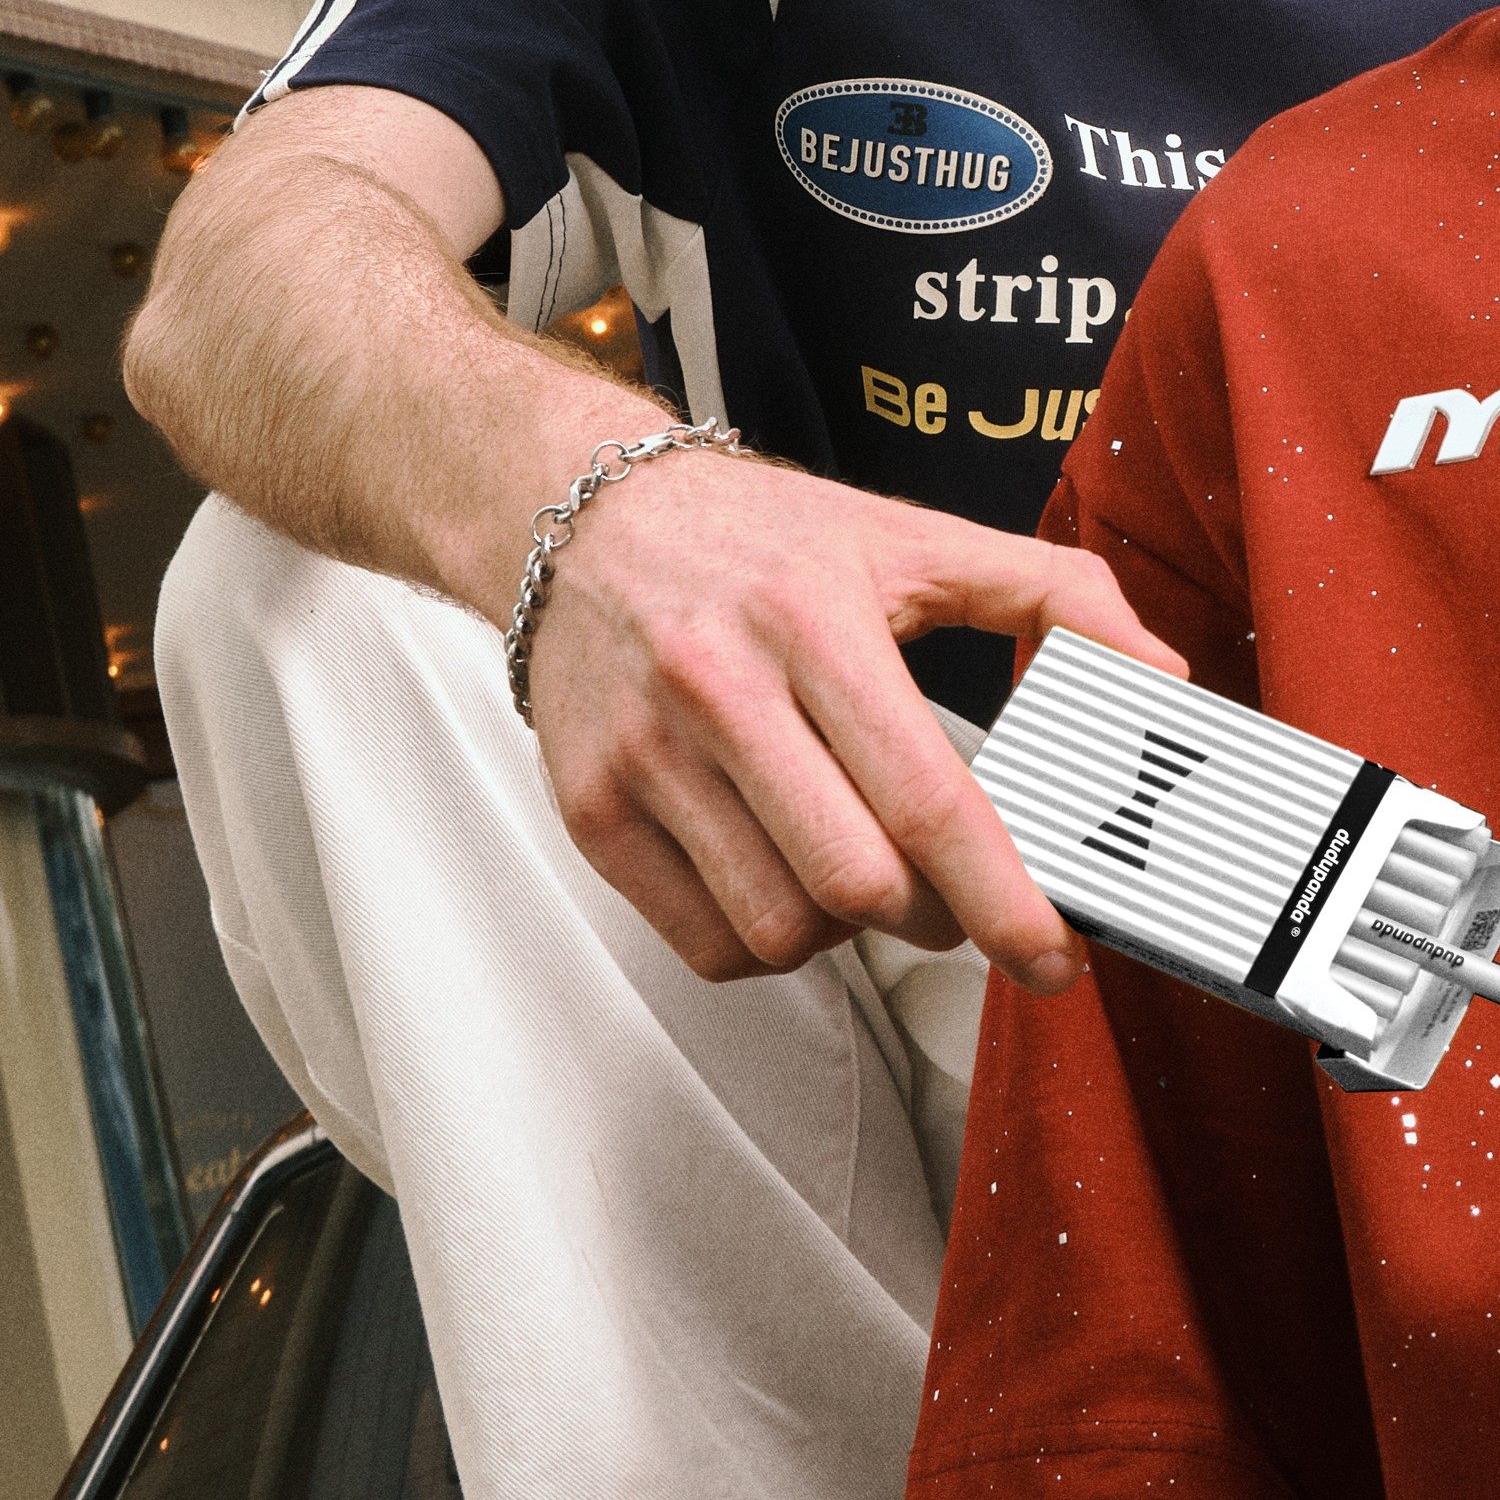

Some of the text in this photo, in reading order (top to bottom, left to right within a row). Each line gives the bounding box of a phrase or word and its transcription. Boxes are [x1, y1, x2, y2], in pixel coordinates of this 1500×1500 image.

[800, 127, 1012, 193] BEJUSTHUG
[1064, 113, 1226, 191] This
[861, 365, 948, 435] Be
[1290, 828, 1351, 924] dudupanda
[1371, 919, 1465, 968] dudupanda
